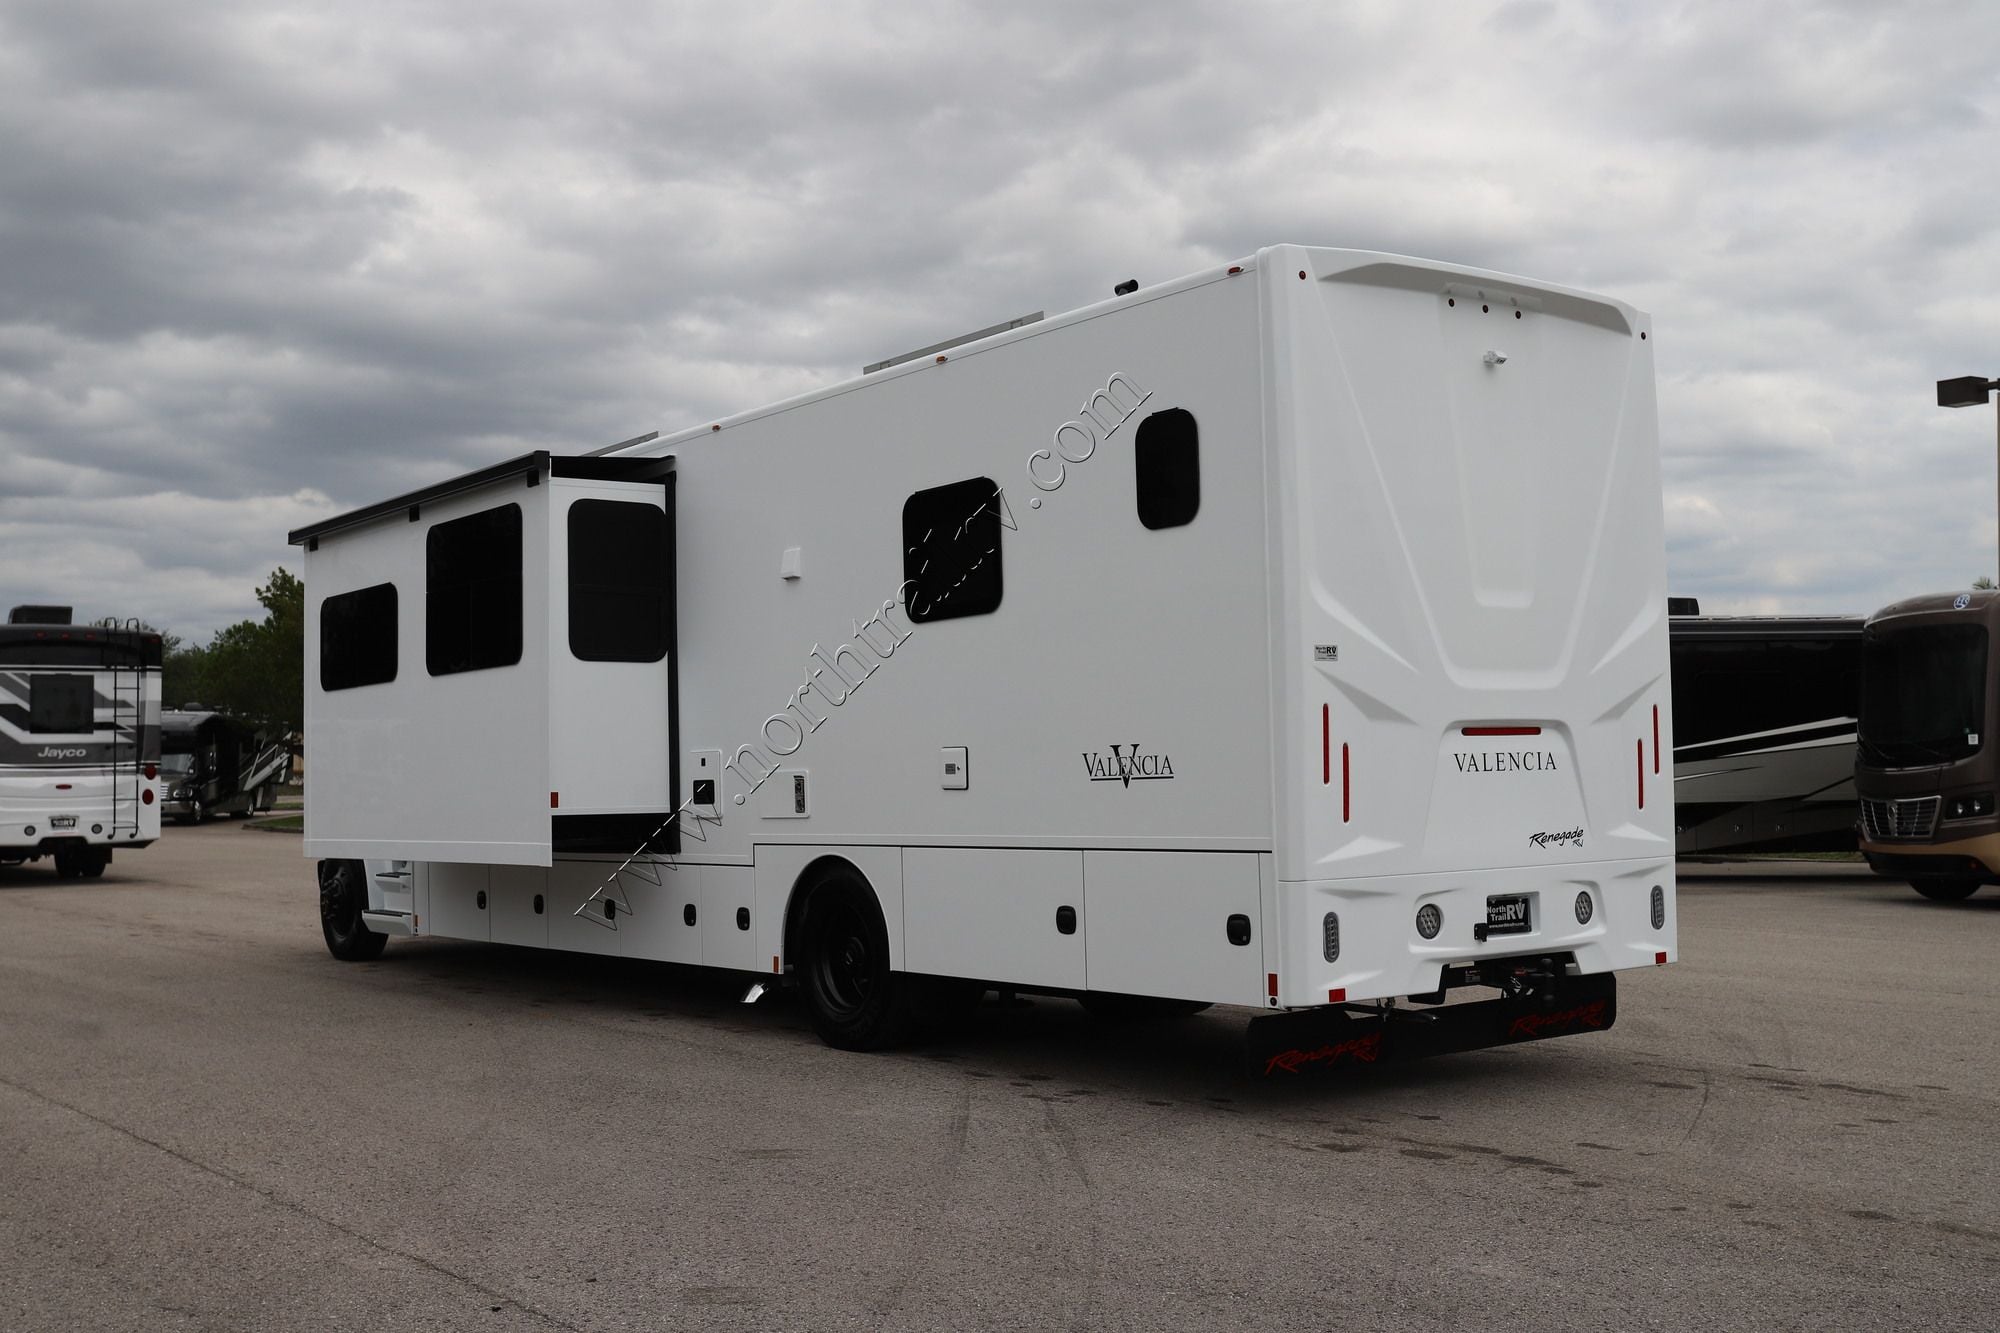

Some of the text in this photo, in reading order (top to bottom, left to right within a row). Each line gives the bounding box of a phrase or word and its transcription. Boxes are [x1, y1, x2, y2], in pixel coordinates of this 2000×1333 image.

[38, 746, 87, 759] Jayco
[1082, 750, 1174, 780] VALENCIA
[1454, 752, 1557, 772] VALENCIA
[1529, 826, 1584, 849] Renegade
[1572, 839, 1584, 848] RV
[1487, 905, 1506, 914] North
[1506, 904, 1525, 920] RV
[1490, 913, 1507, 921] Trail
